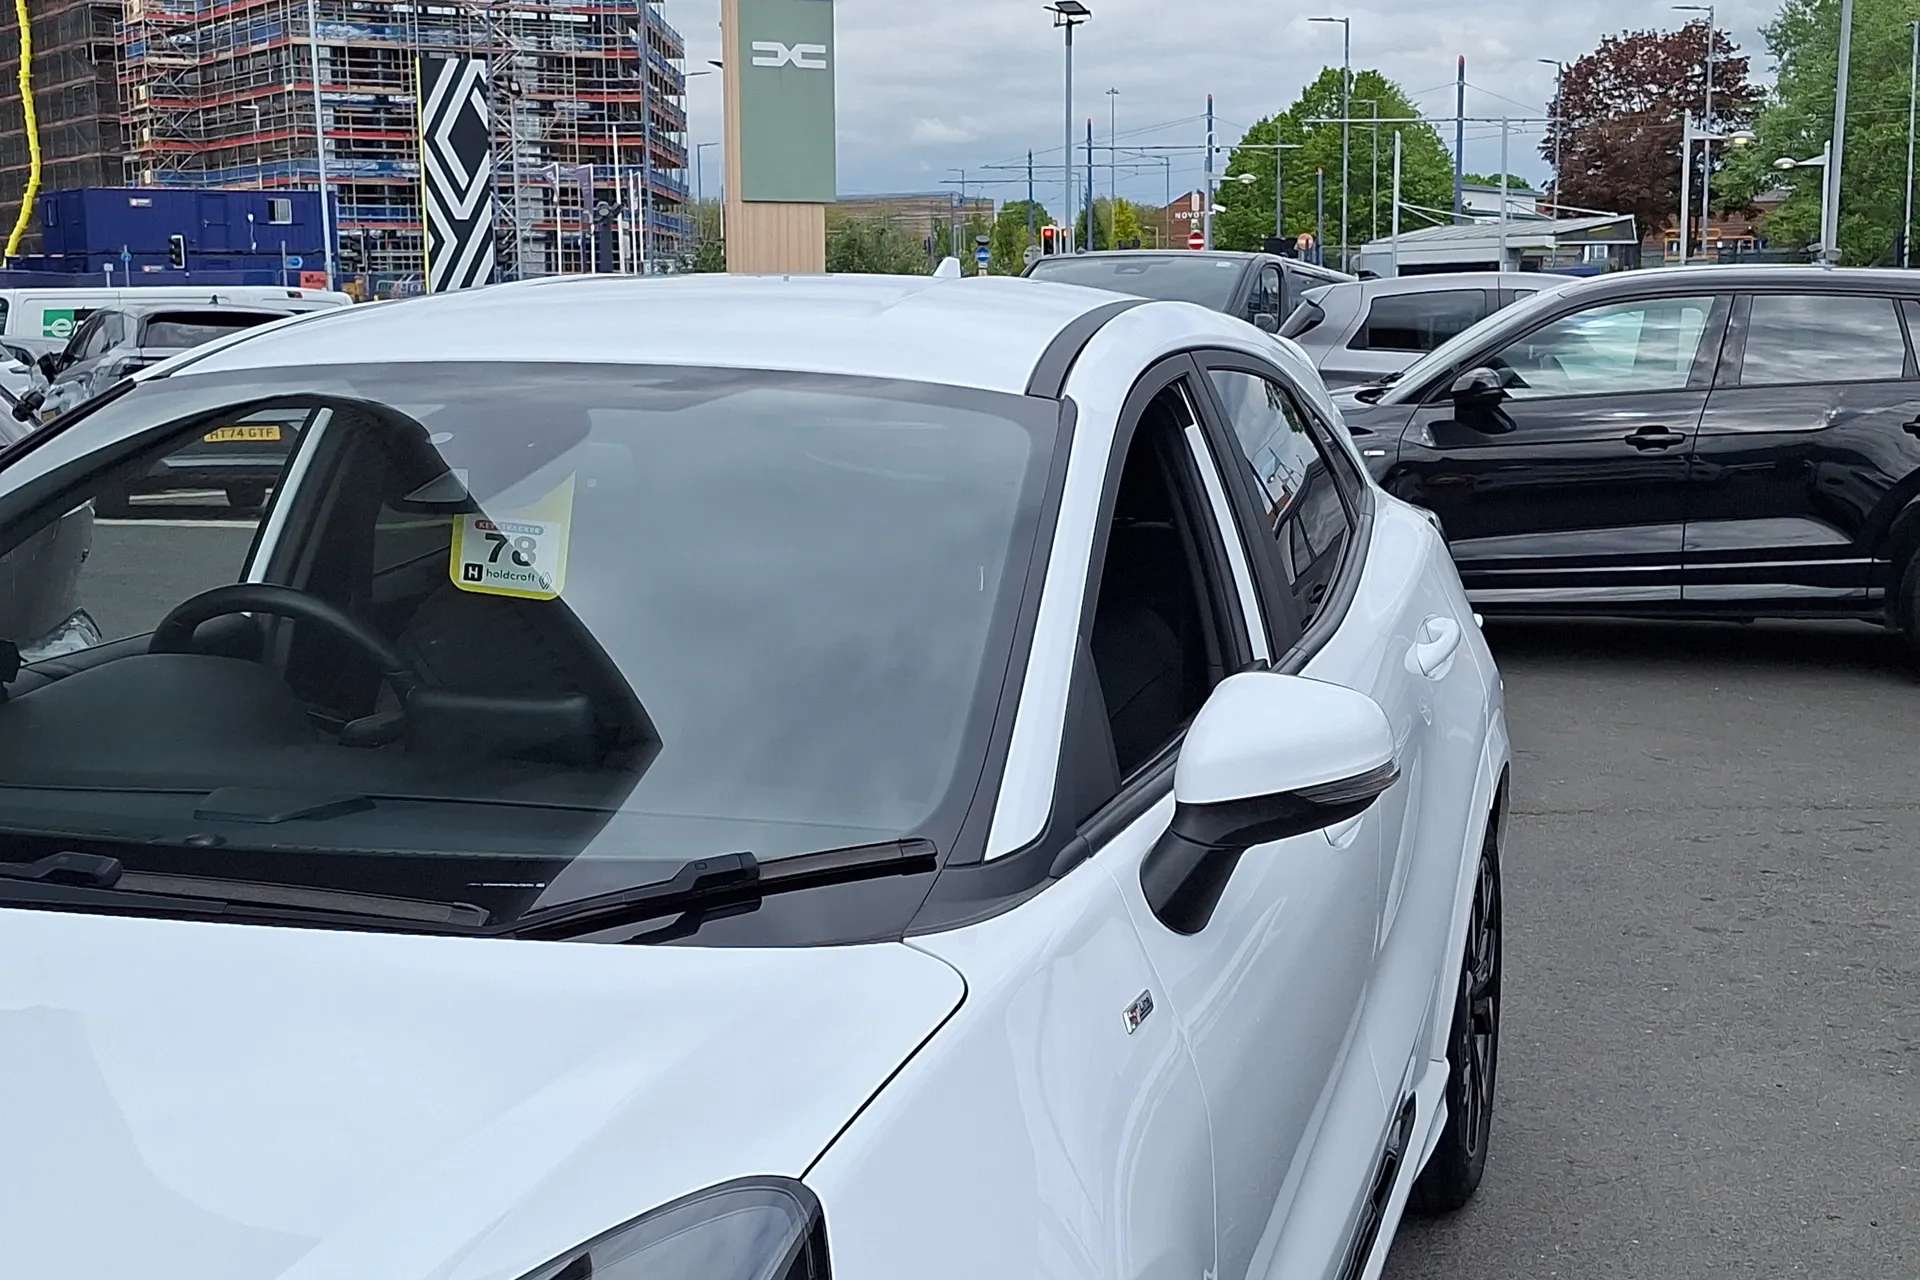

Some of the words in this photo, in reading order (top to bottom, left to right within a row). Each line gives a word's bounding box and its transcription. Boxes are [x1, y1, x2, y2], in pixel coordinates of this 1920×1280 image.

[1174, 211, 1204, 219] NOVOT
[485, 533, 537, 567] 78
[486, 568, 535, 582] holdcroft
